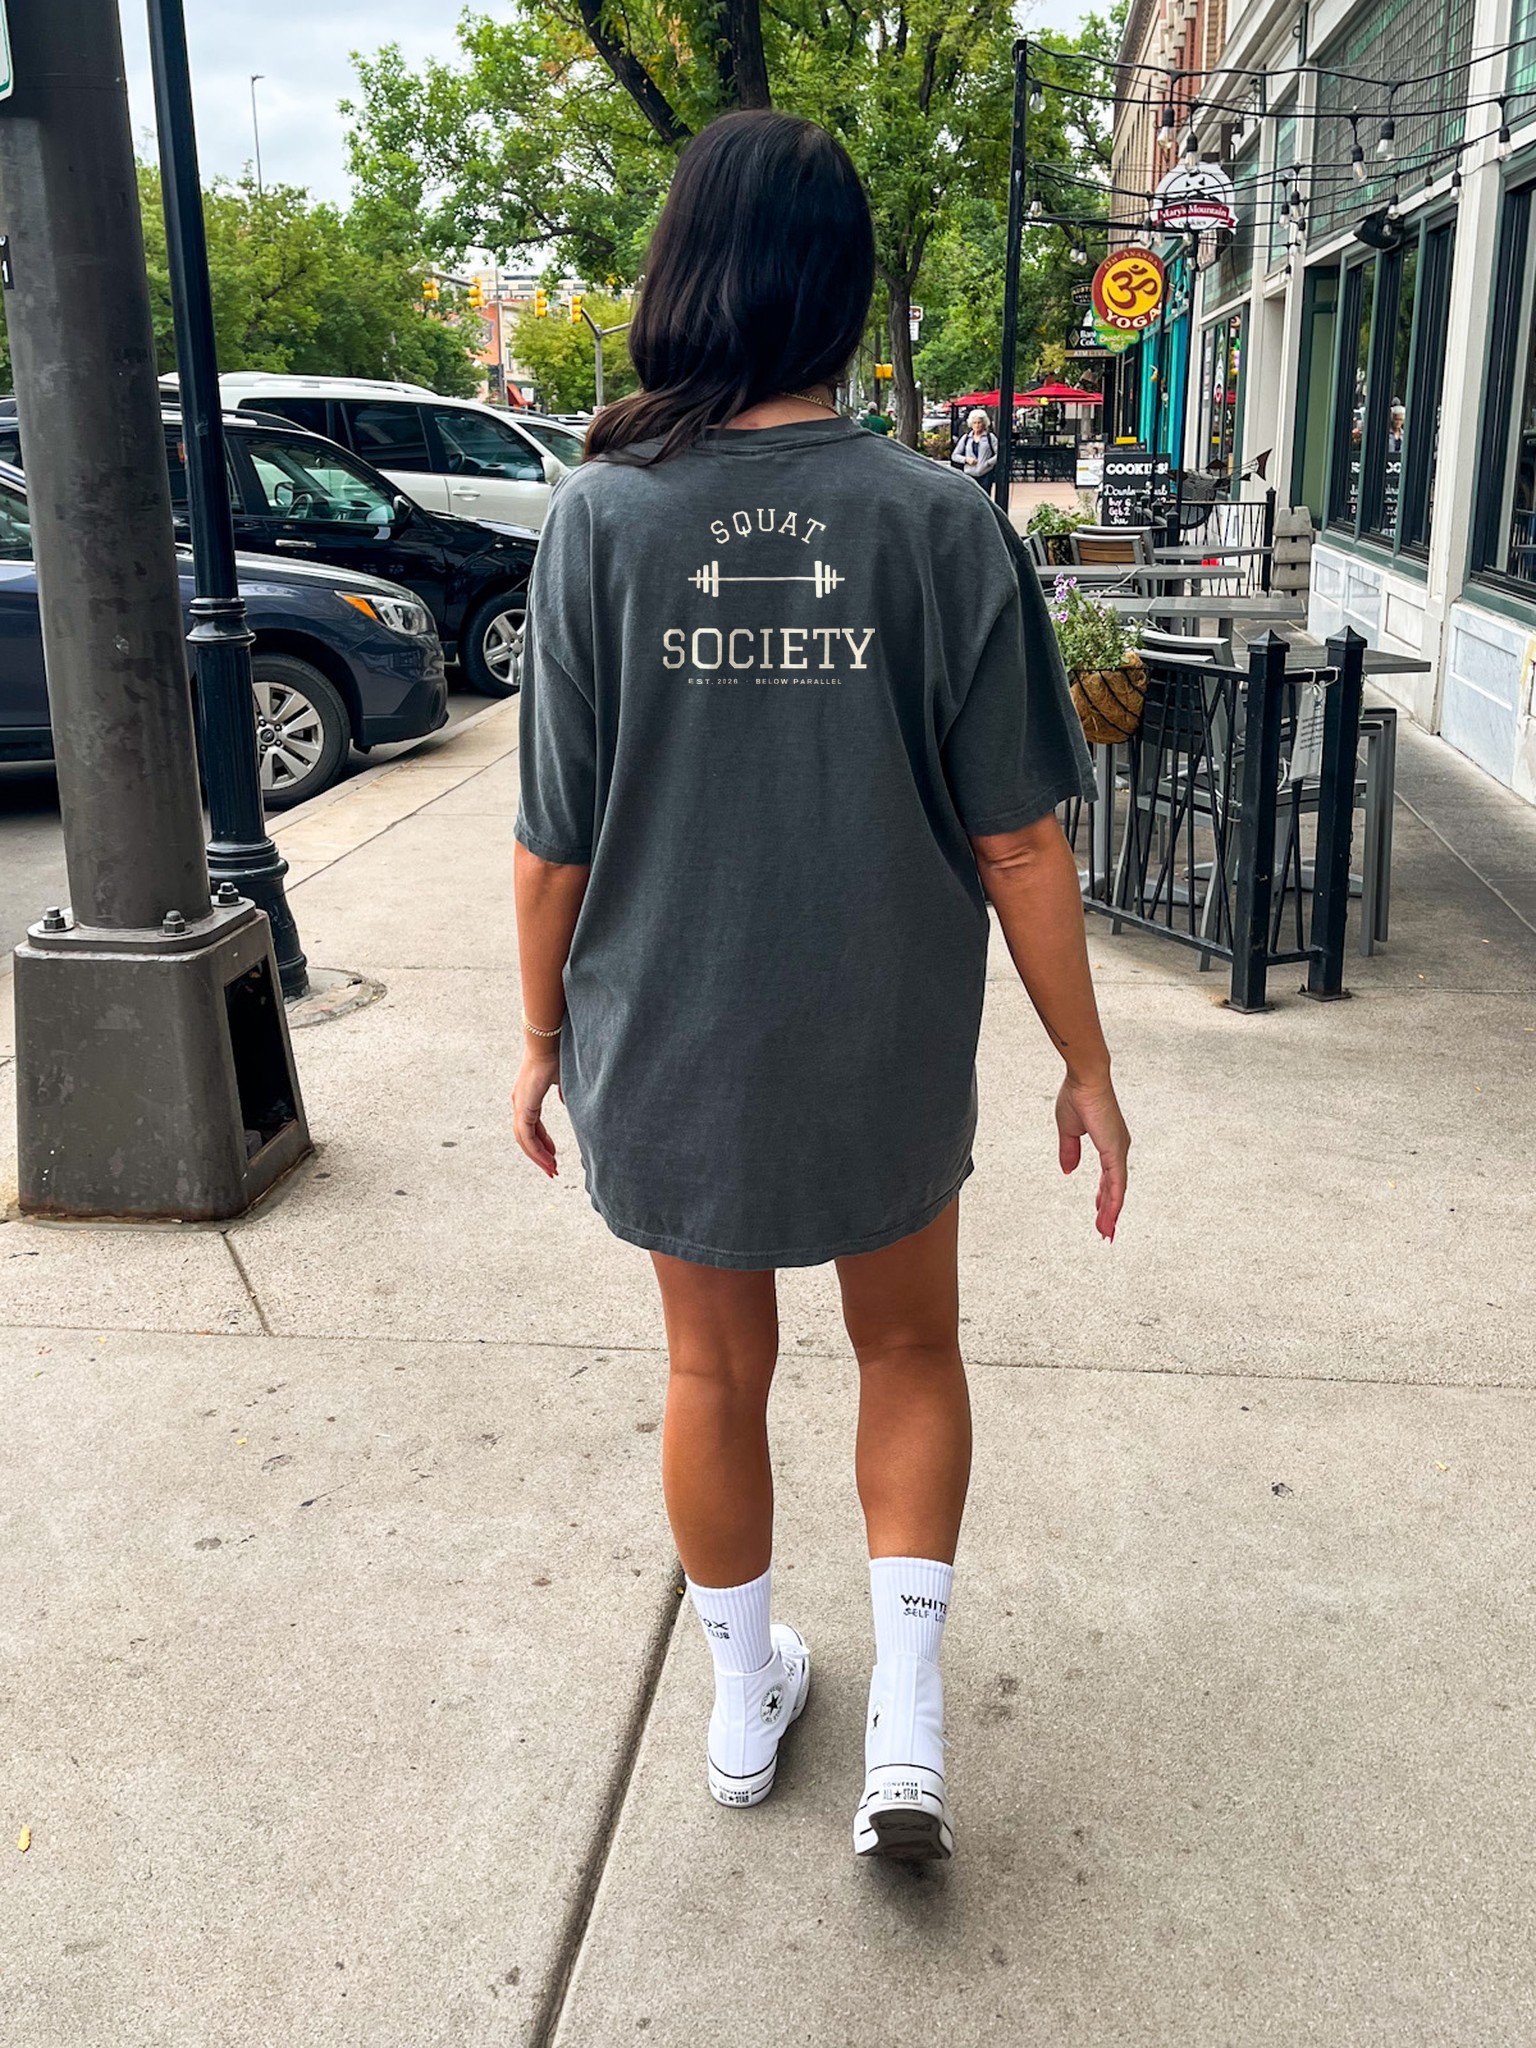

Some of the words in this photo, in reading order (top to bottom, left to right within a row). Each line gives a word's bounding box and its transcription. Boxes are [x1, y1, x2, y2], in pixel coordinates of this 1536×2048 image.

[1161, 205, 1186, 218] Mary's
[1188, 204, 1227, 217] Mountain
[1106, 302, 1162, 328] YOGA
[710, 508, 826, 545] SQUAT
[662, 628, 876, 670] SOCIETY
[903, 1607, 930, 1619] SELF
